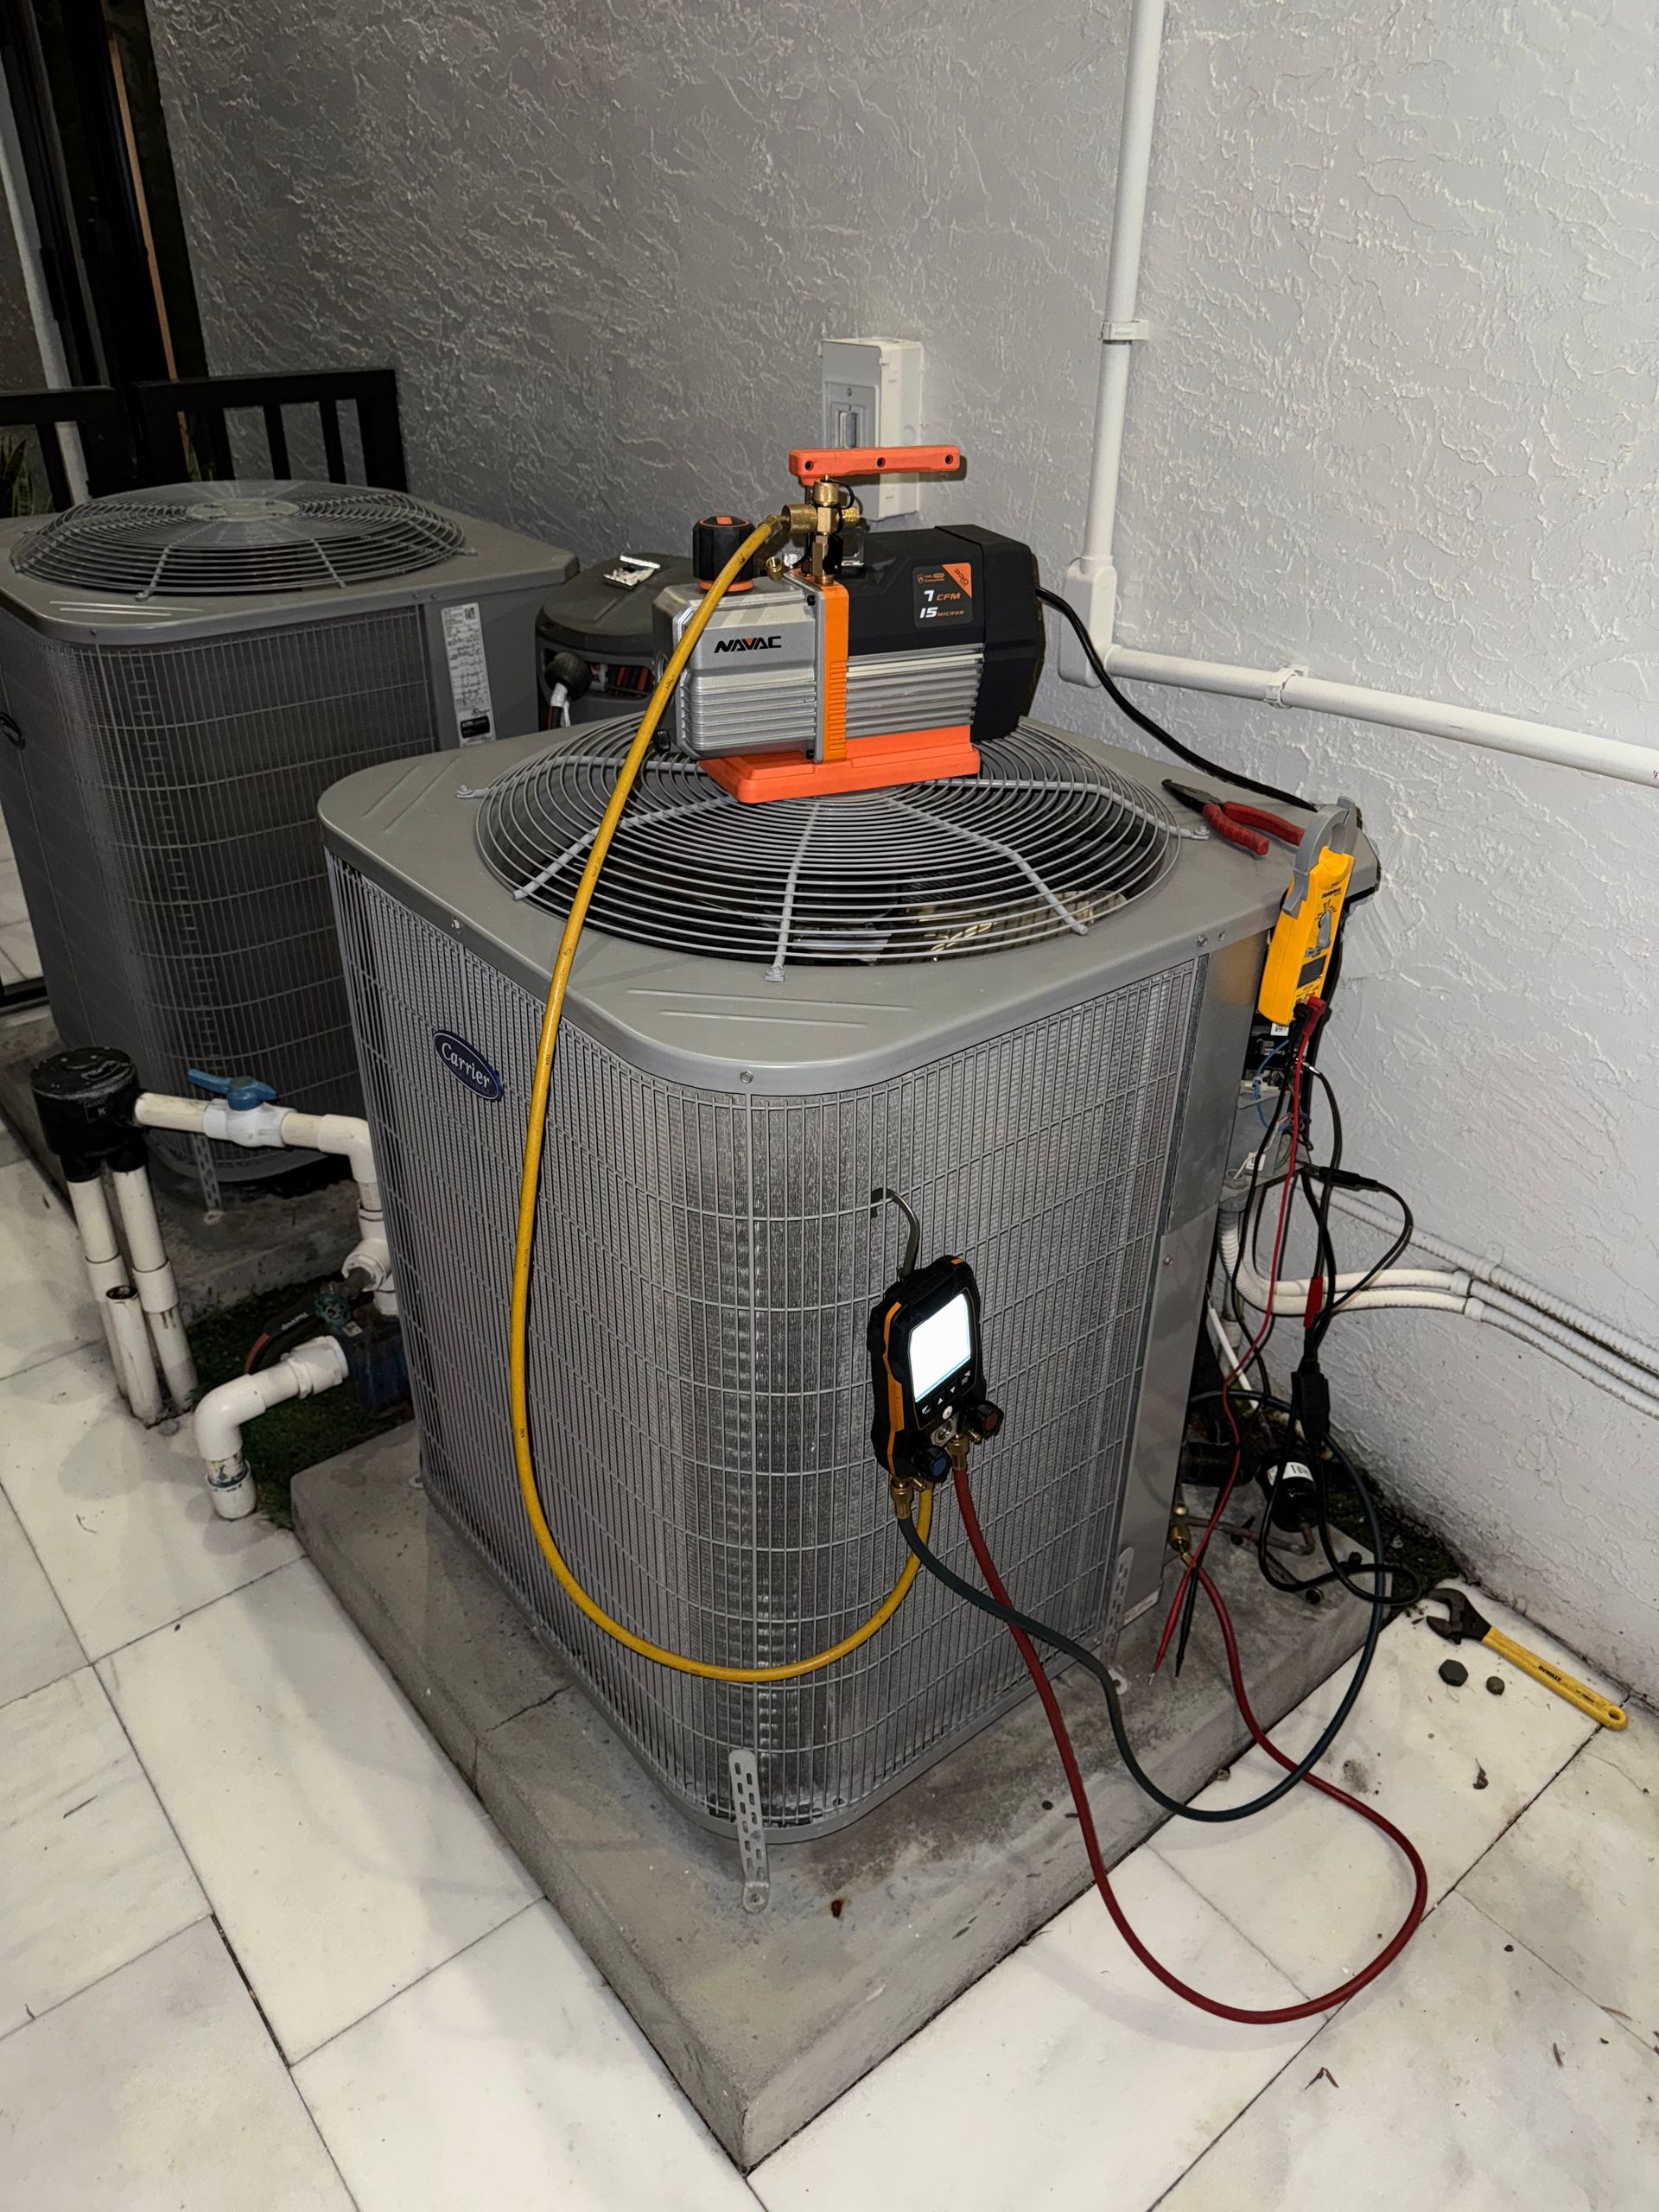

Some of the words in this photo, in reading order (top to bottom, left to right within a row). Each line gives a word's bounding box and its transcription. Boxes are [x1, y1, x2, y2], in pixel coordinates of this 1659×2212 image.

[954, 569, 969, 585] PRO
[924, 589, 934, 602] 7
[936, 593, 961, 601] CFM
[919, 607, 938, 619] 15
[714, 636, 782, 654] NAVAC
[442, 1042, 490, 1089] Carrier
